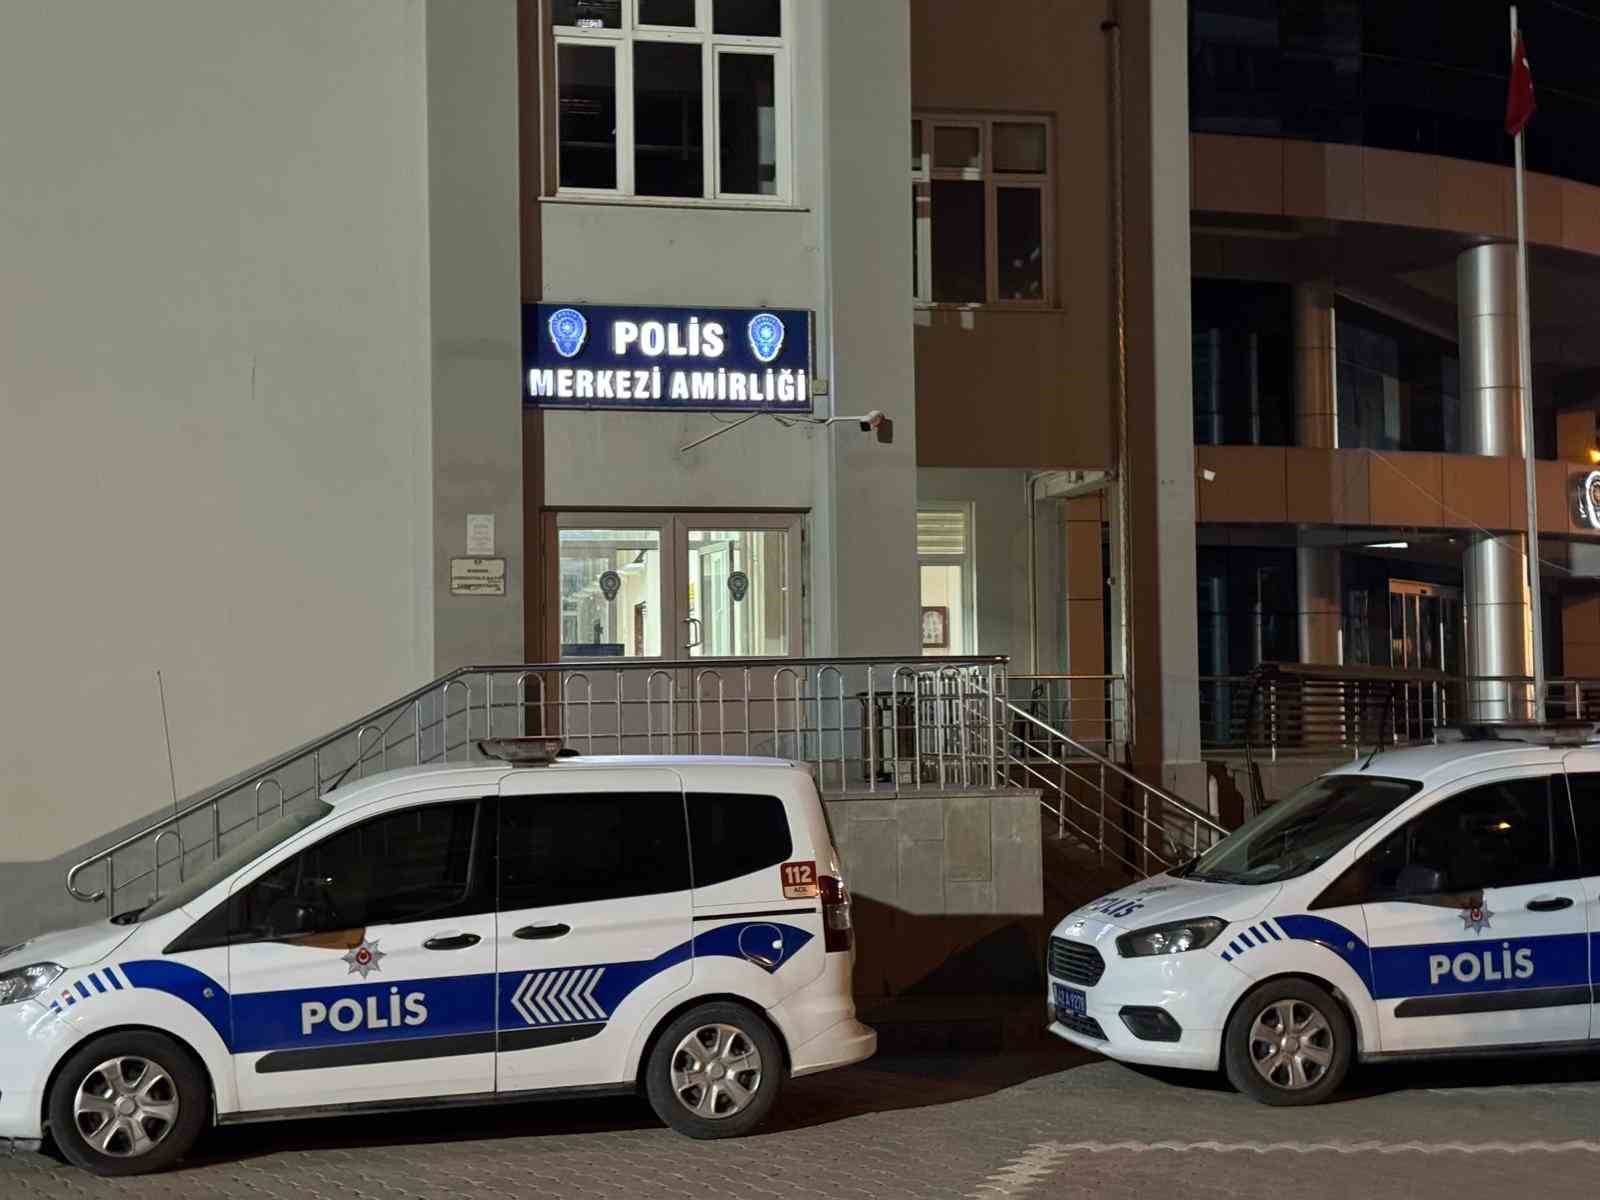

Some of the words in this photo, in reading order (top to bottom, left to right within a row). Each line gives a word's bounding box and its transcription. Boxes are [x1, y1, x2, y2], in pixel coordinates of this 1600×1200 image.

[612, 316, 725, 358] POLİS
[528, 366, 662, 400] MERKEZİ
[670, 367, 807, 402] AMİRLİĞİ
[785, 866, 812, 884] 112
[1429, 942, 1535, 985] POLİS
[301, 985, 428, 1035] POLİS
